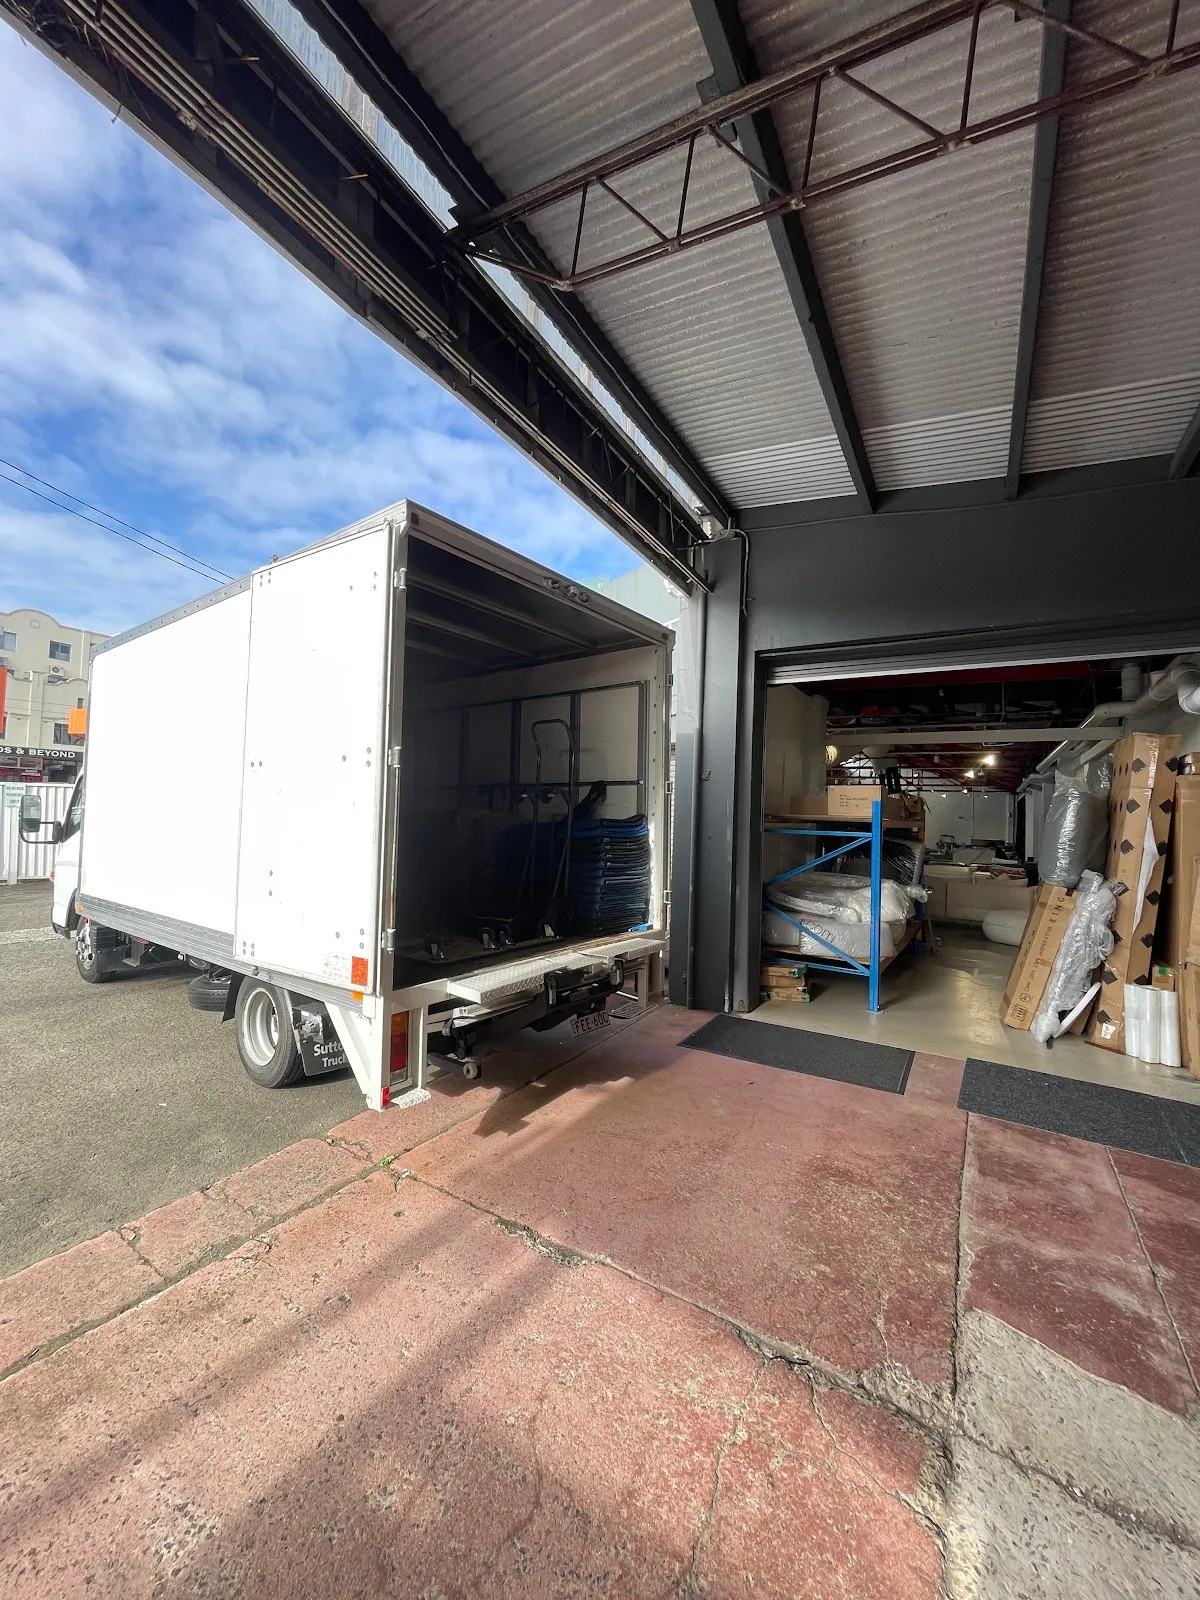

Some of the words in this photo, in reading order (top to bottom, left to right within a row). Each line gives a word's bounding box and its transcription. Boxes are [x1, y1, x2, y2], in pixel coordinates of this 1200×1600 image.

[16, 747, 24, 755] &
[28, 748, 76, 758] BEYOND
[1051, 896, 1065, 924] KING
